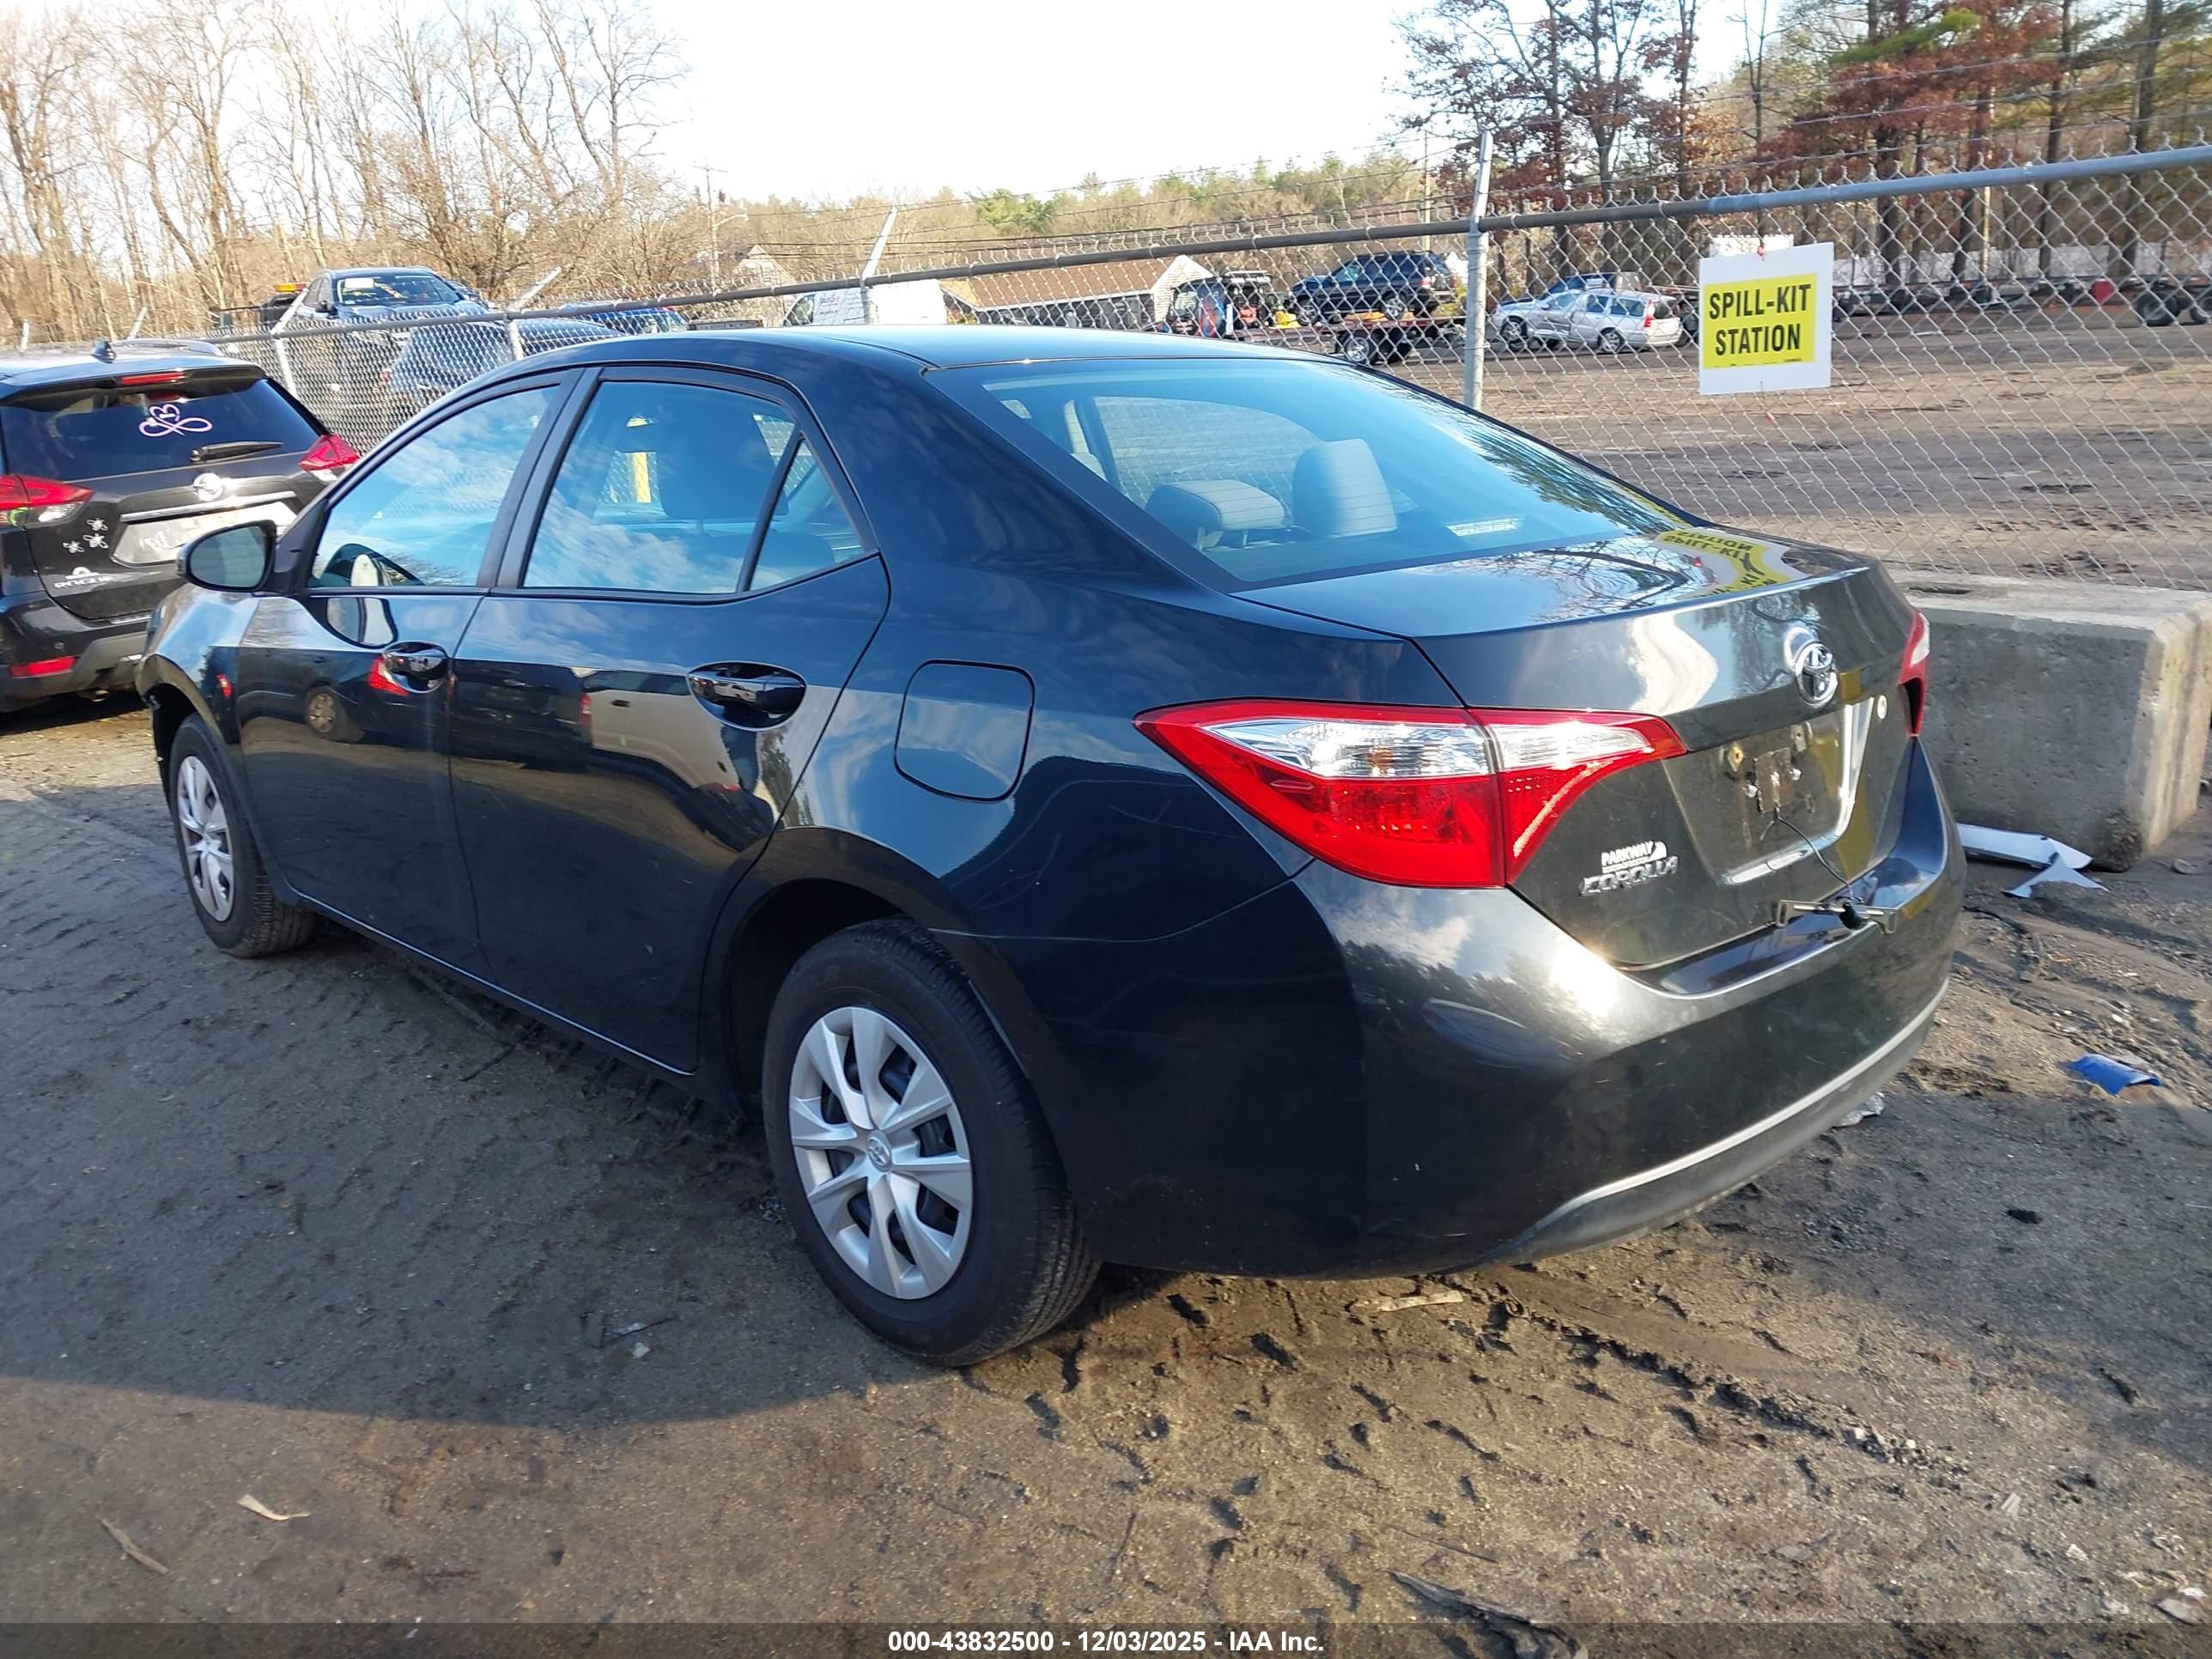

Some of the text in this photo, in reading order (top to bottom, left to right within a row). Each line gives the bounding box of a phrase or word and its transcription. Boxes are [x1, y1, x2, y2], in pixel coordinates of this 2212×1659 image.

[1709, 284, 1811, 319] SPILL-KIT
[1716, 324, 1801, 356] STATION
[1601, 841, 1654, 866] PARKWAY
[1580, 856, 1679, 896] COROLLA
